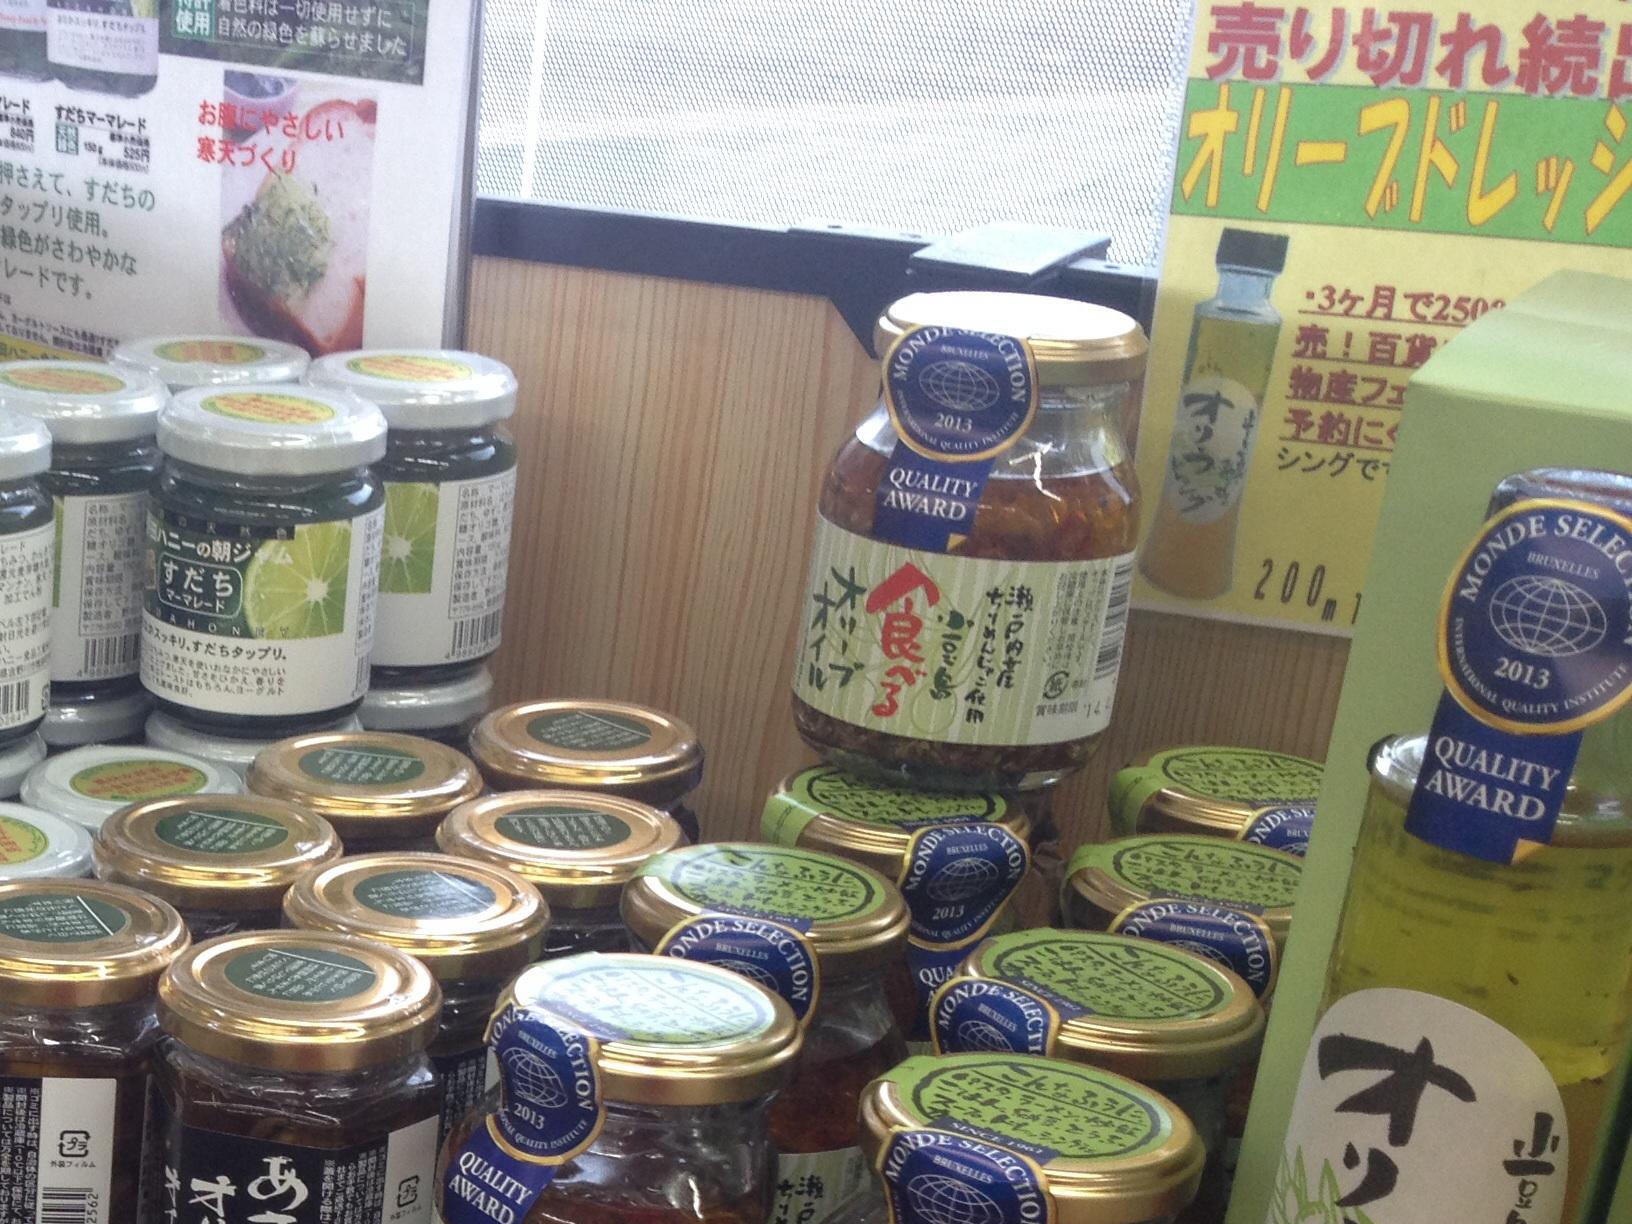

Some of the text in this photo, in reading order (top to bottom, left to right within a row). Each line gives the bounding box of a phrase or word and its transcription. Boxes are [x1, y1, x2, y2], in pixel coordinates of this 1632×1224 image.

[55, 104, 147, 134] すだちマーマレード
[198, 100, 345, 142] お腹にやさしい
[197, 136, 296, 176] 寒天づくり
[933, 411, 974, 433] 2013
[1278, 447, 1390, 481] シングで
[888, 465, 979, 499] QUALITY
[883, 491, 968, 522] AWARD
[1459, 514, 1548, 604] MONDE
[1526, 550, 1601, 580] BRUXELLES
[162, 560, 234, 598] すだち
[165, 589, 226, 613] マーマレード
[1493, 656, 1550, 690] 2013
[1501, 699, 1560, 715] QUALITY
[1434, 736, 1561, 792] QUALITY
[1424, 769, 1547, 821] AWARD
[931, 903, 965, 921] 2013
[732, 916, 808, 1002] SELECTION
[1184, 902, 1265, 984] SELECTION
[939, 980, 1000, 1033] MONDE
[513, 1102, 545, 1130] 2013
[884, 1130, 964, 1184] MONDE
[932, 1154, 995, 1185] BRUXELLES
[458, 1150, 533, 1206] QUALITY
